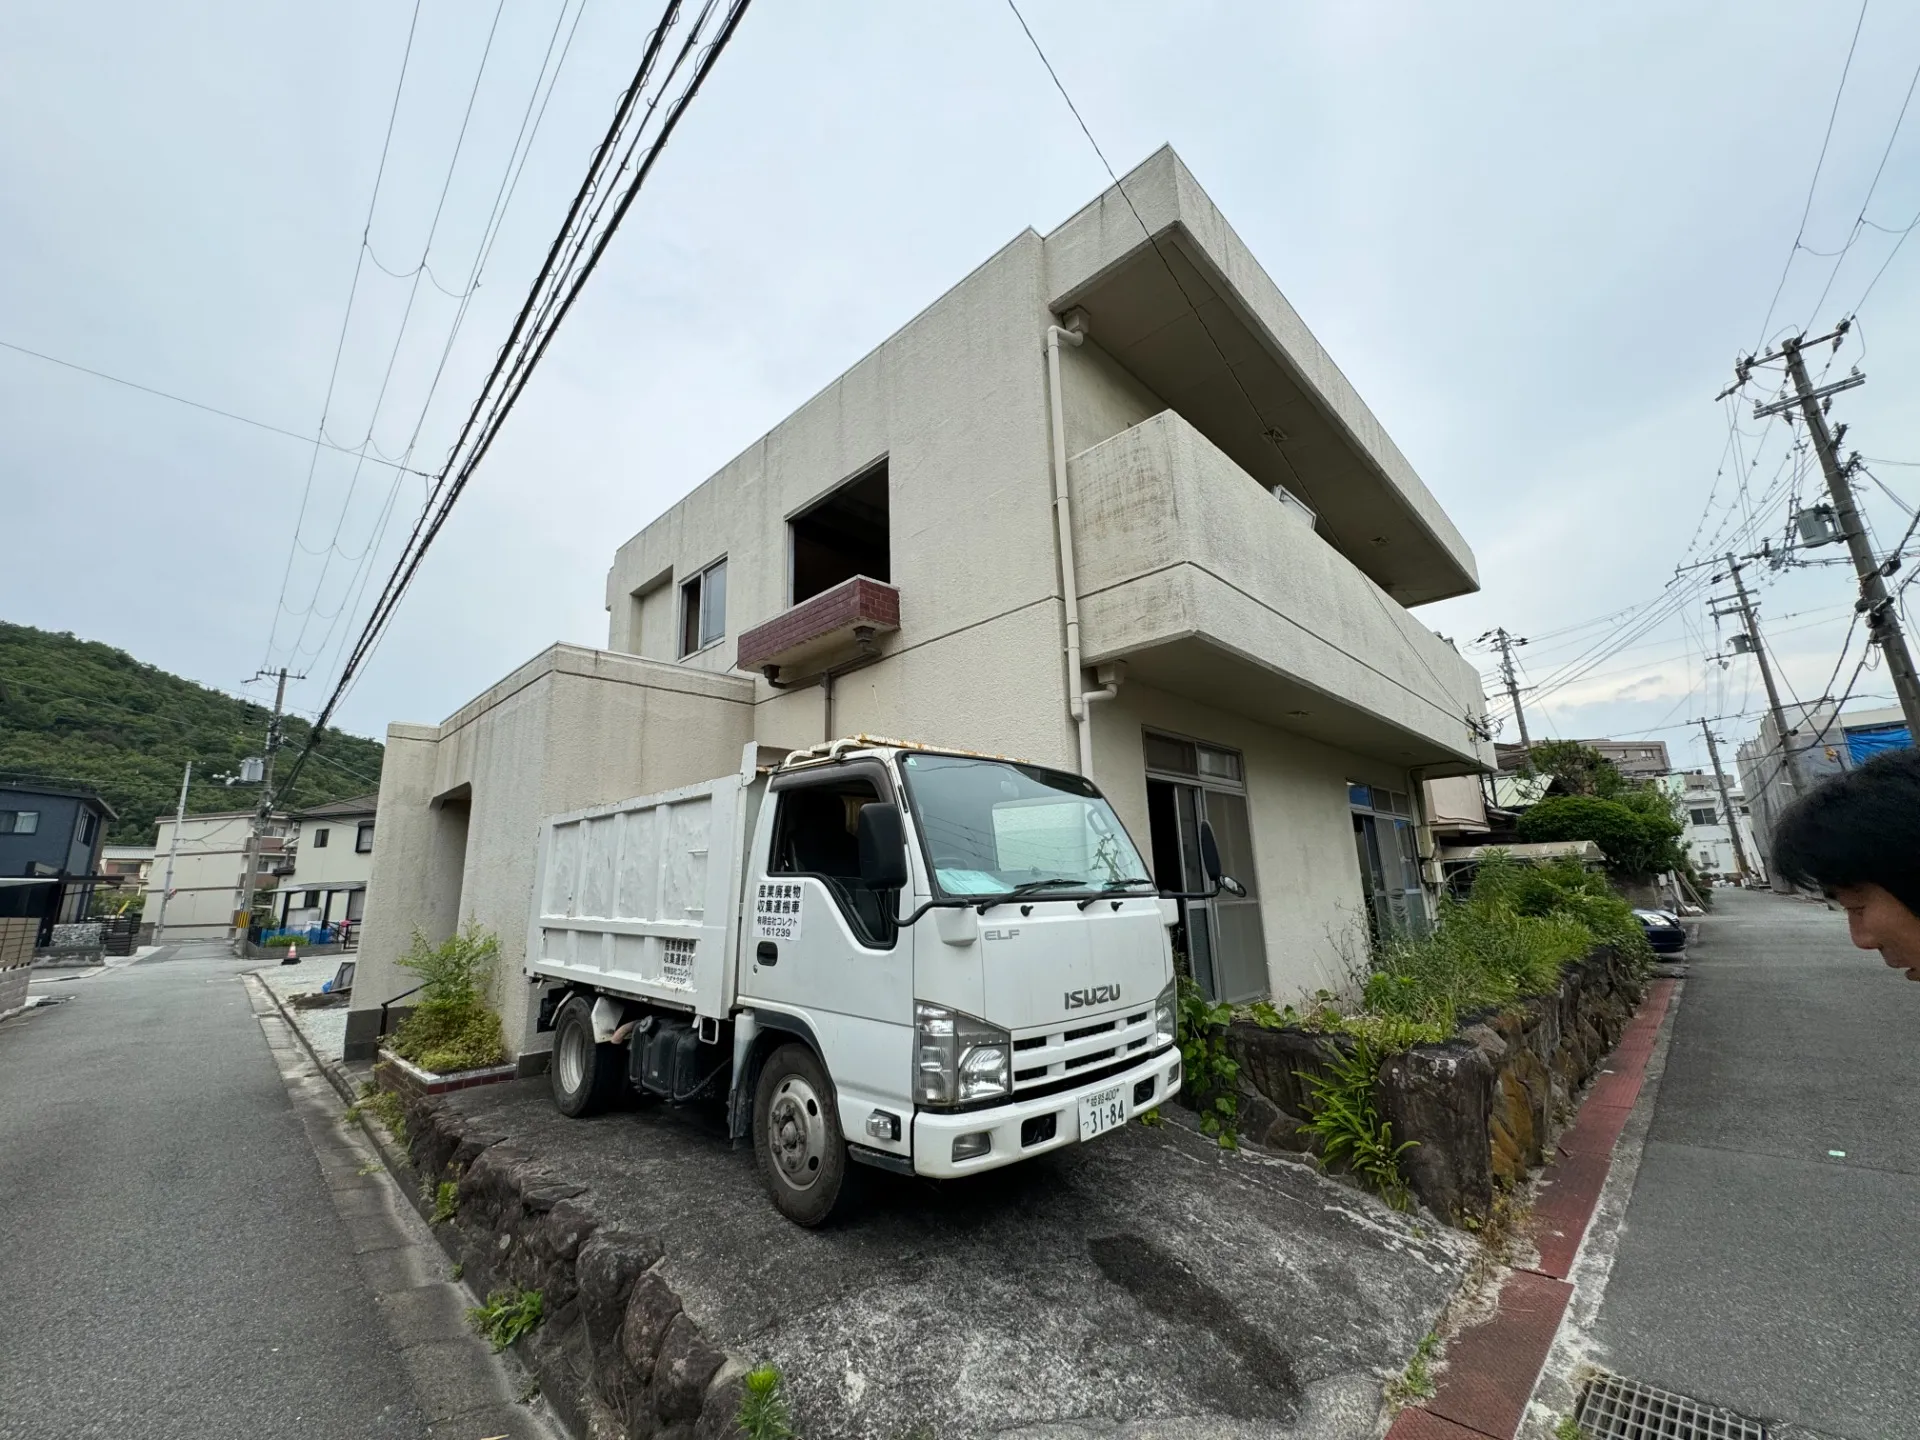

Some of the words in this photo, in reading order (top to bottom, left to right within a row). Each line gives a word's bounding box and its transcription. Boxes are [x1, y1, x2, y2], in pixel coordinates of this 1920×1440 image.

[758, 885, 801, 899] 産業廃棄物
[757, 899, 800, 914] 収集運搬車
[757, 916, 797, 927] 有限会社コレクト
[762, 927, 791, 937] 161239
[984, 929, 1020, 941] ELF
[1064, 984, 1120, 1010] ISUZU
[1090, 1100, 1124, 1134] 31-84
